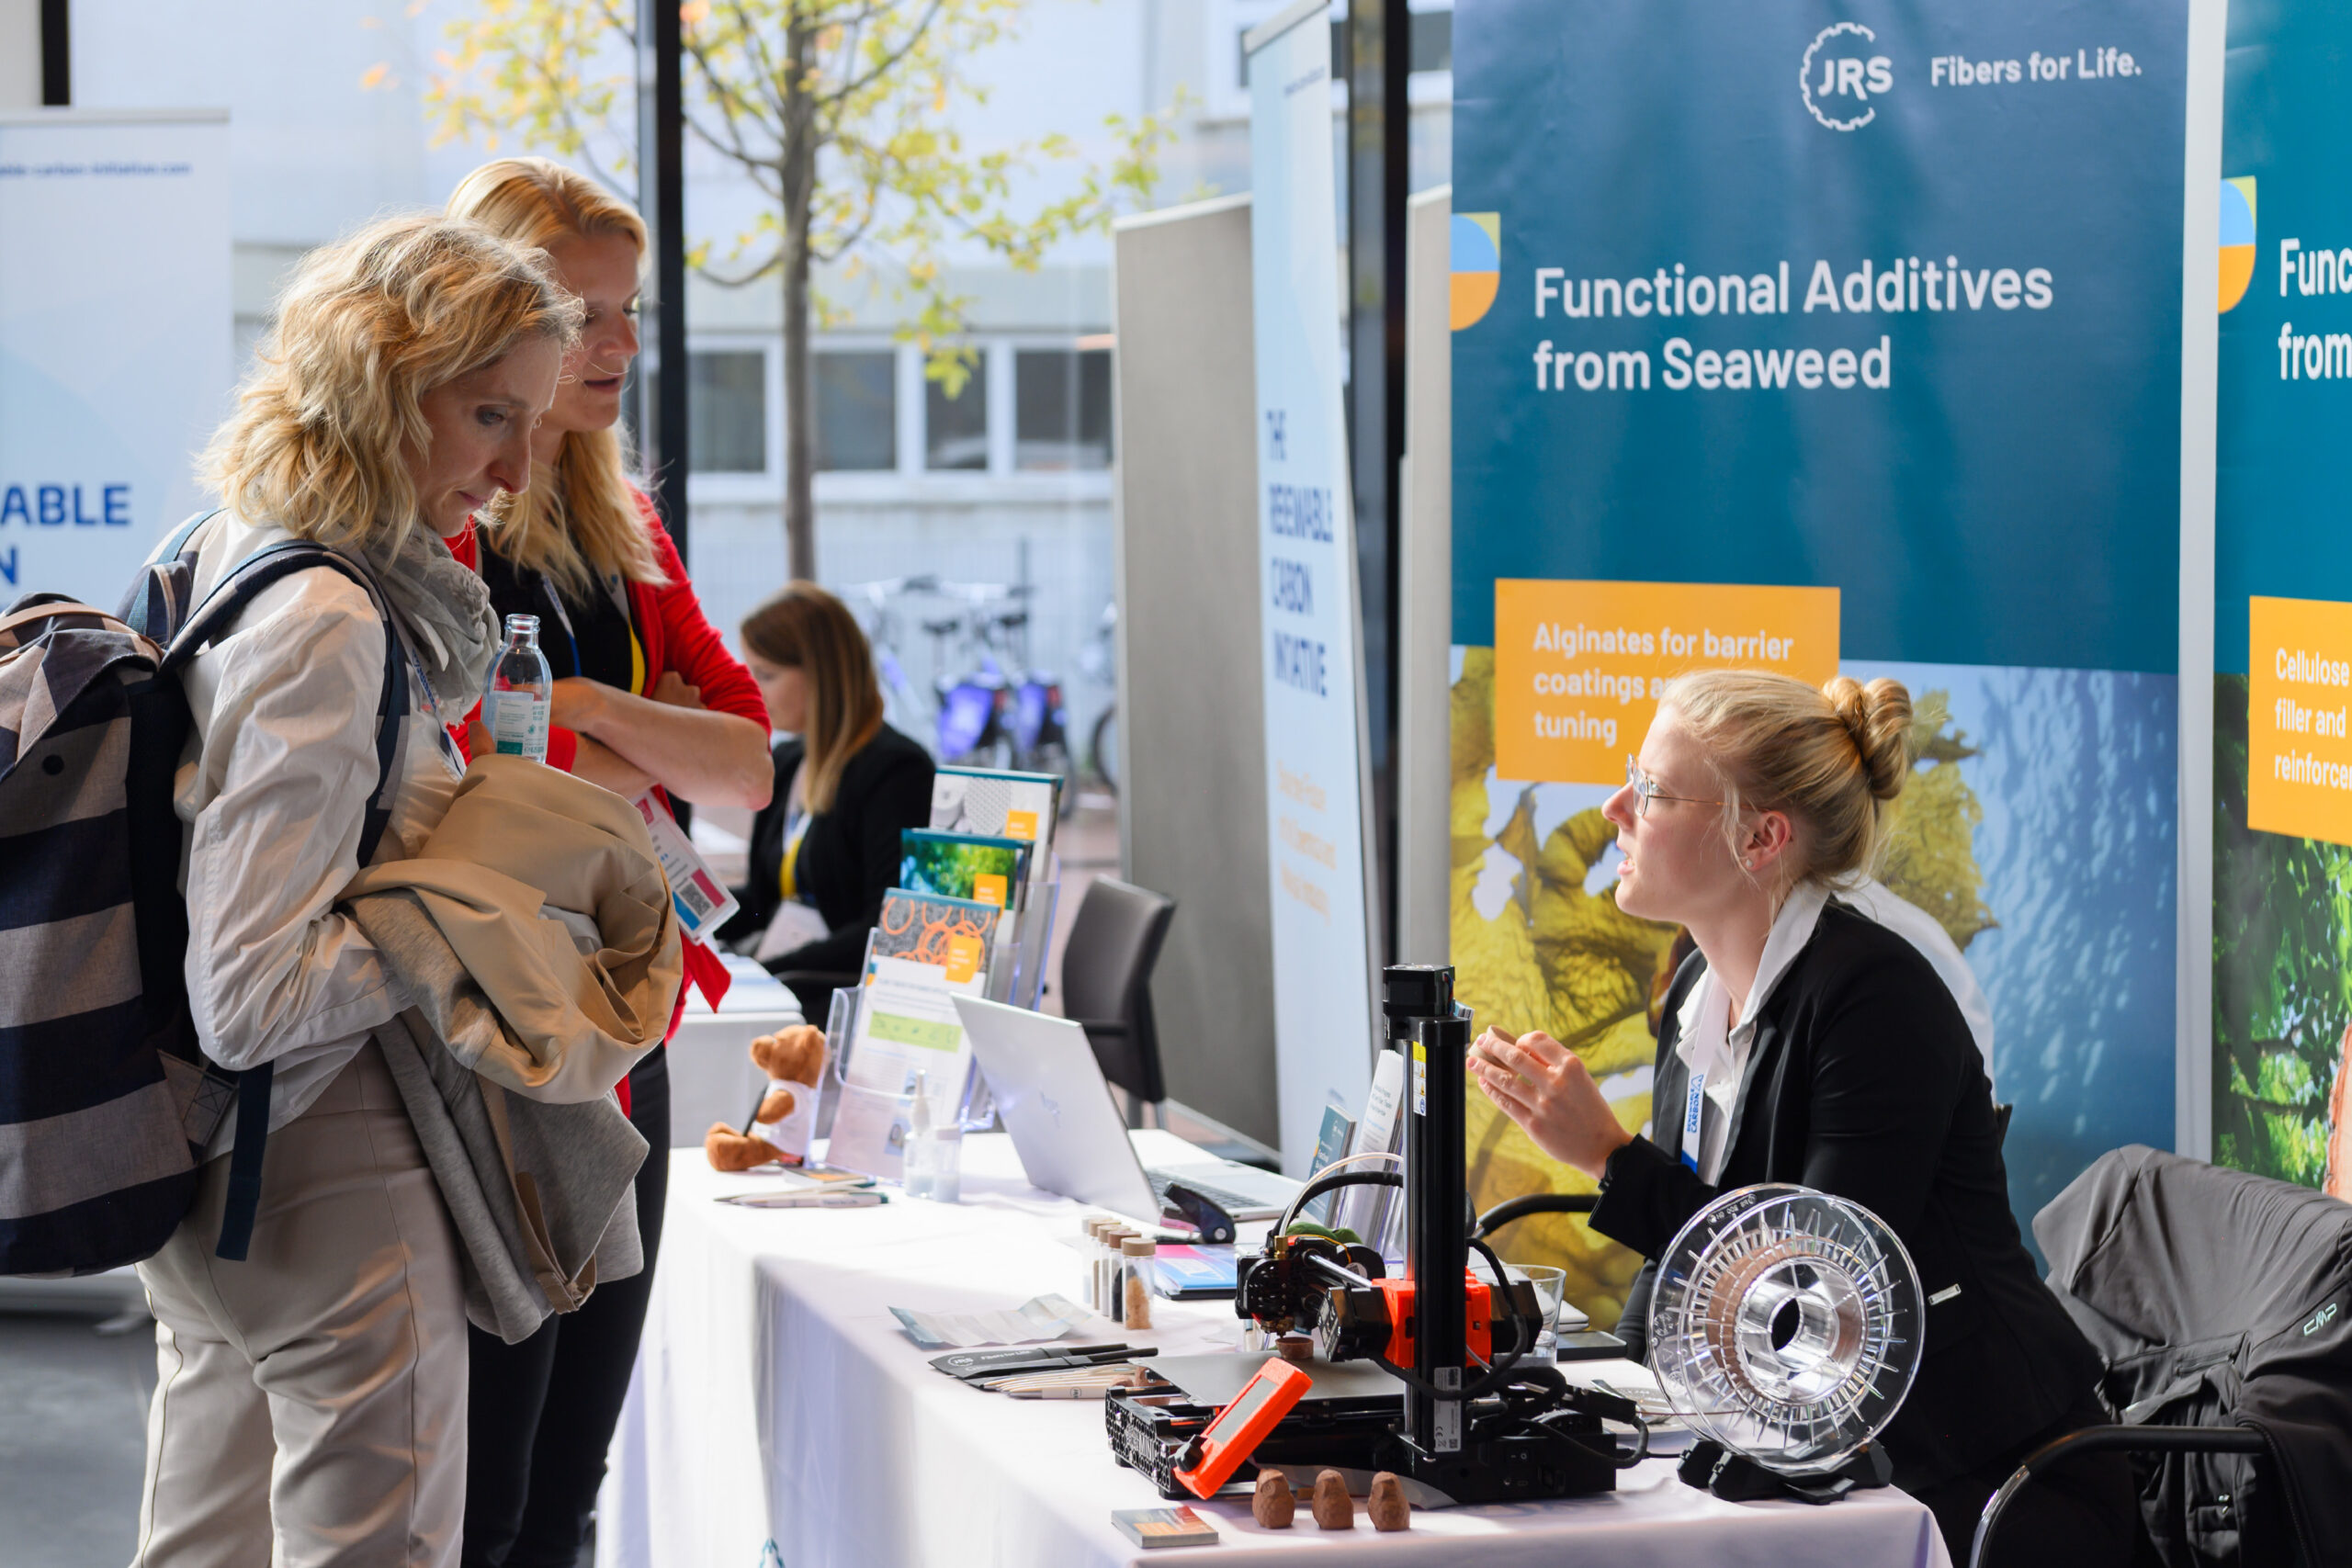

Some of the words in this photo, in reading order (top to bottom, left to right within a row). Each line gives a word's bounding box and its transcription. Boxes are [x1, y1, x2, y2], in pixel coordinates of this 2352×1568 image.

[1817, 56, 1894, 100] JRS
[1930, 56, 2021, 87] Fibers
[2028, 51, 2072, 81] for
[2077, 47, 2143, 79] Life.
[1534, 261, 1790, 318] Functional
[1803, 255, 2053, 313] Additives
[2279, 238, 2352, 297] Func
[1533, 339, 1651, 391] from
[1662, 334, 1891, 389] Seaweed
[2278, 321, 2352, 381] from
[0, 484, 130, 526] ABLE
[1532, 622, 1654, 659] Alginates
[1660, 626, 1696, 657] for
[1703, 628, 1793, 660] barrier
[1533, 668, 1645, 705] coatings
[2275, 648, 2350, 687] Cellulose
[1533, 712, 1617, 748] tuning
[2275, 698, 2312, 733] filler
[2315, 705, 2346, 739] and
[1690, 1093, 1700, 1133] CARBON
[2303, 1303, 2337, 1337] CMP
